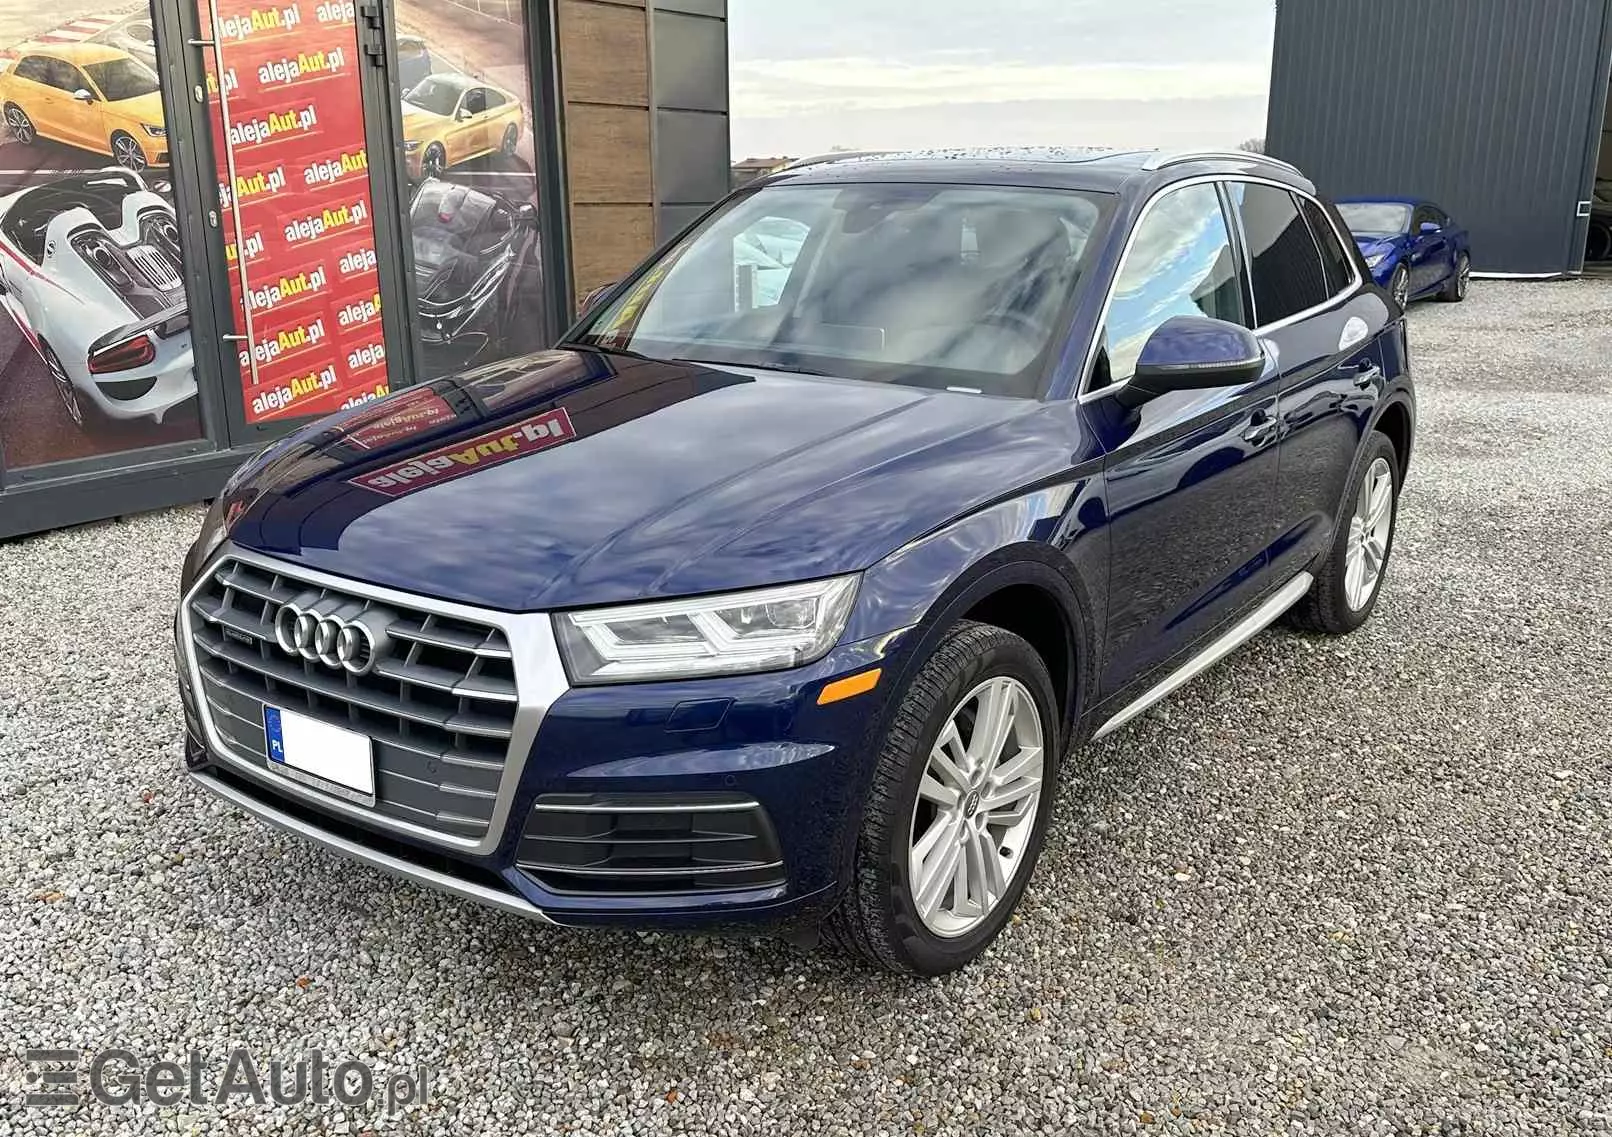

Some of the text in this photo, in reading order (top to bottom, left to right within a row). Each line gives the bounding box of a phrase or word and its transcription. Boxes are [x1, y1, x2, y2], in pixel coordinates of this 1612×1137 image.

[209, 4, 300, 40] lejaAut.pl
[258, 47, 345, 83] alejaAut.pl
[231, 105, 317, 144] alejaAut.pl
[304, 150, 368, 184] alejaAut
[284, 199, 368, 242] alejaAut.pl
[339, 248, 376, 273] aleja
[240, 265, 326, 311] lejaAut.pl
[239, 318, 325, 366] aejaAut.pl
[348, 343, 385, 369] aleja
[252, 365, 337, 414] alejaAut.pl
[271, 739, 284, 753] PL
